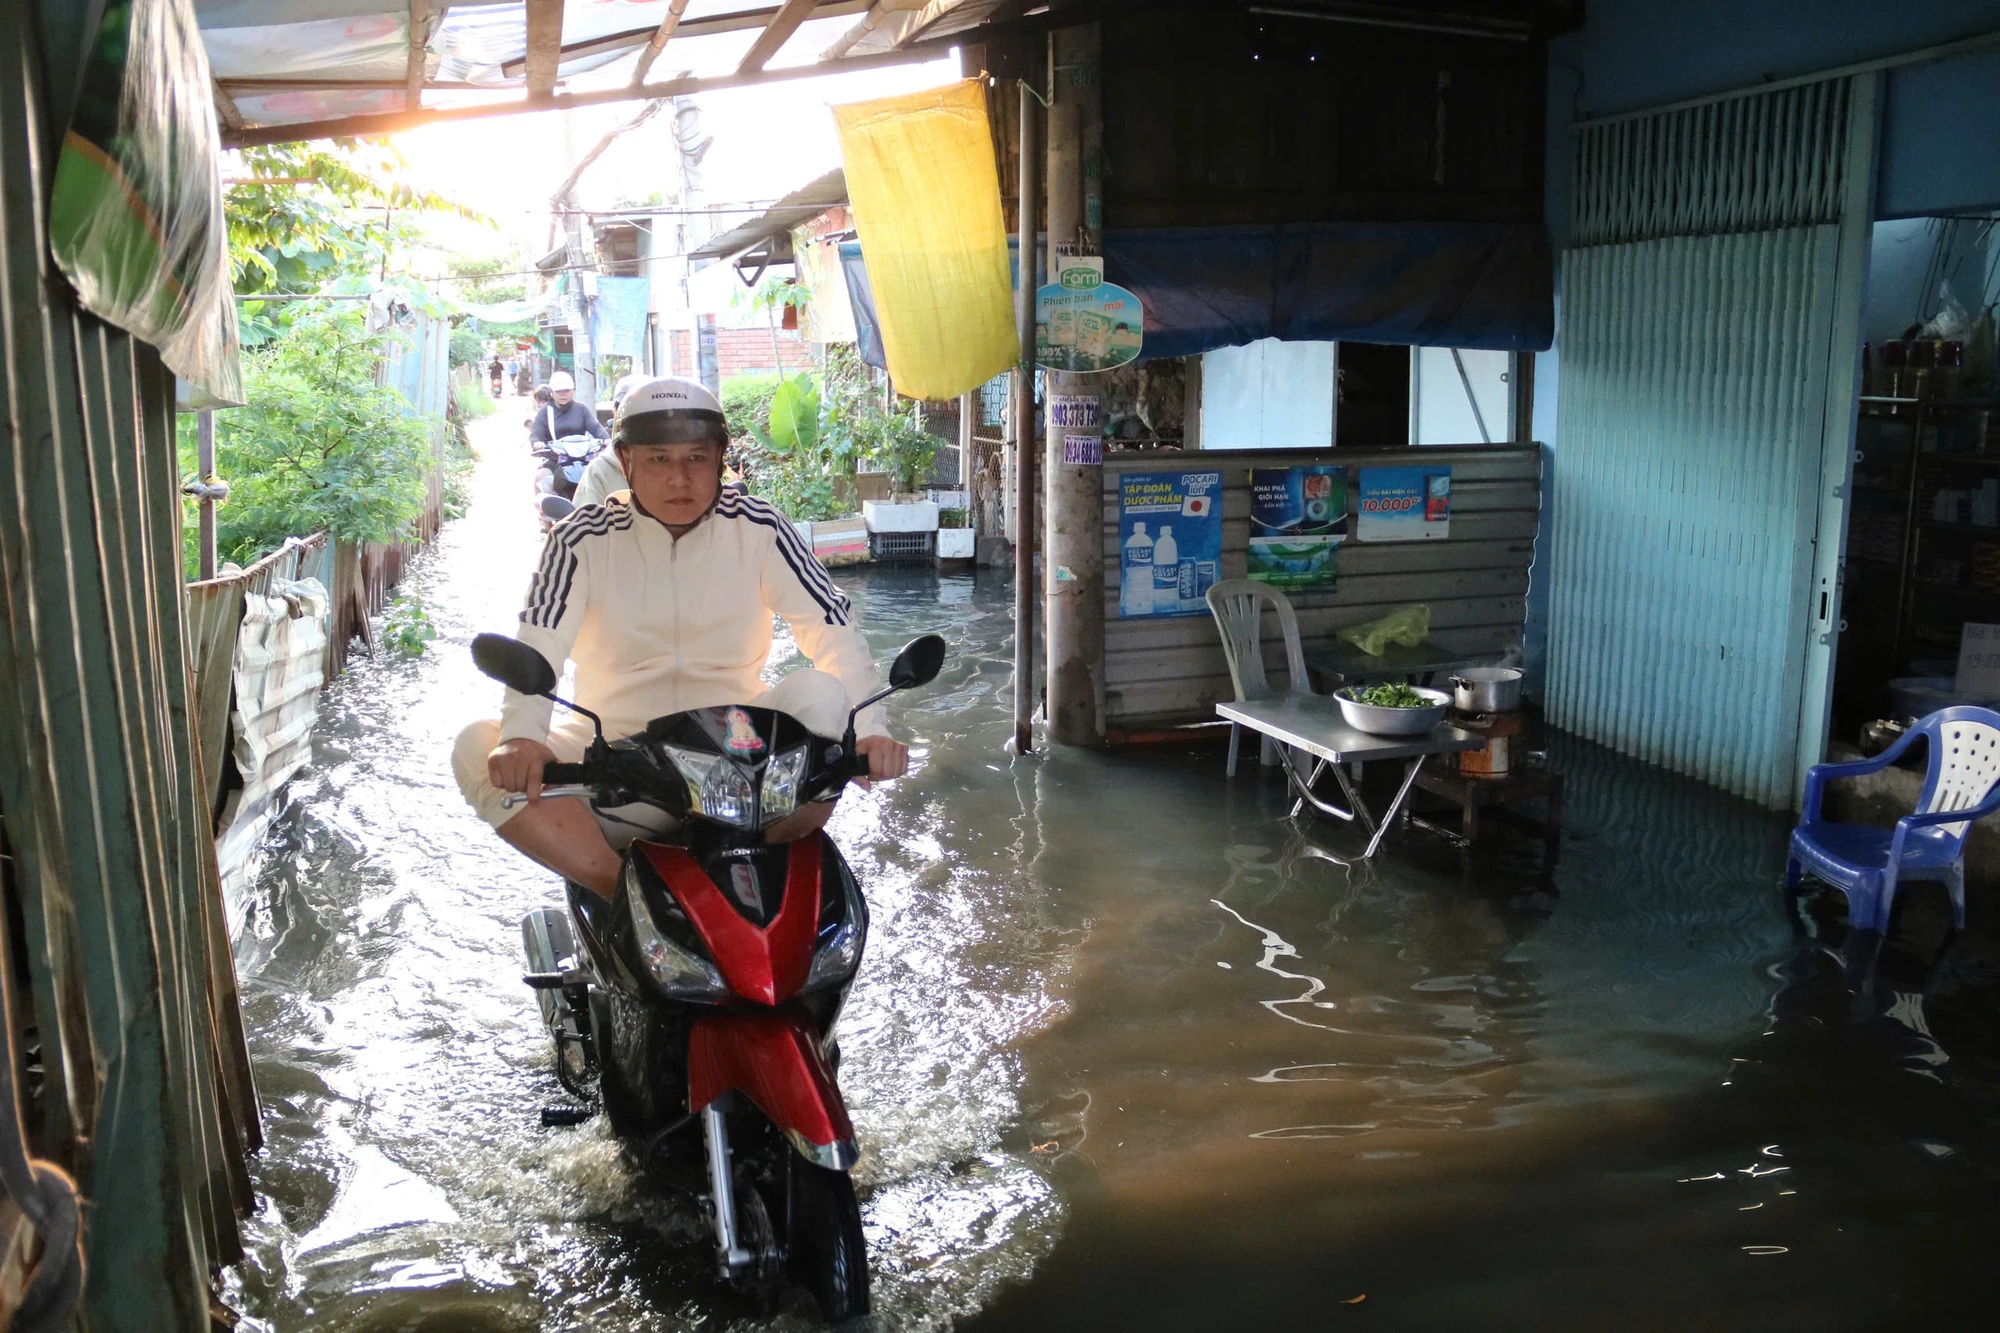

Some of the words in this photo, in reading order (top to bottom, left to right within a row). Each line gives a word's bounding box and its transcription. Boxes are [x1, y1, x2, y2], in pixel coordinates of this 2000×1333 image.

[1063, 270, 1099, 284] Fami
[1182, 473, 1218, 485] POCARI
[1124, 484, 1142, 496] TẬP
[1144, 482, 1172, 493] ĐOÀN
[1153, 492, 1182, 504] PHẨM
